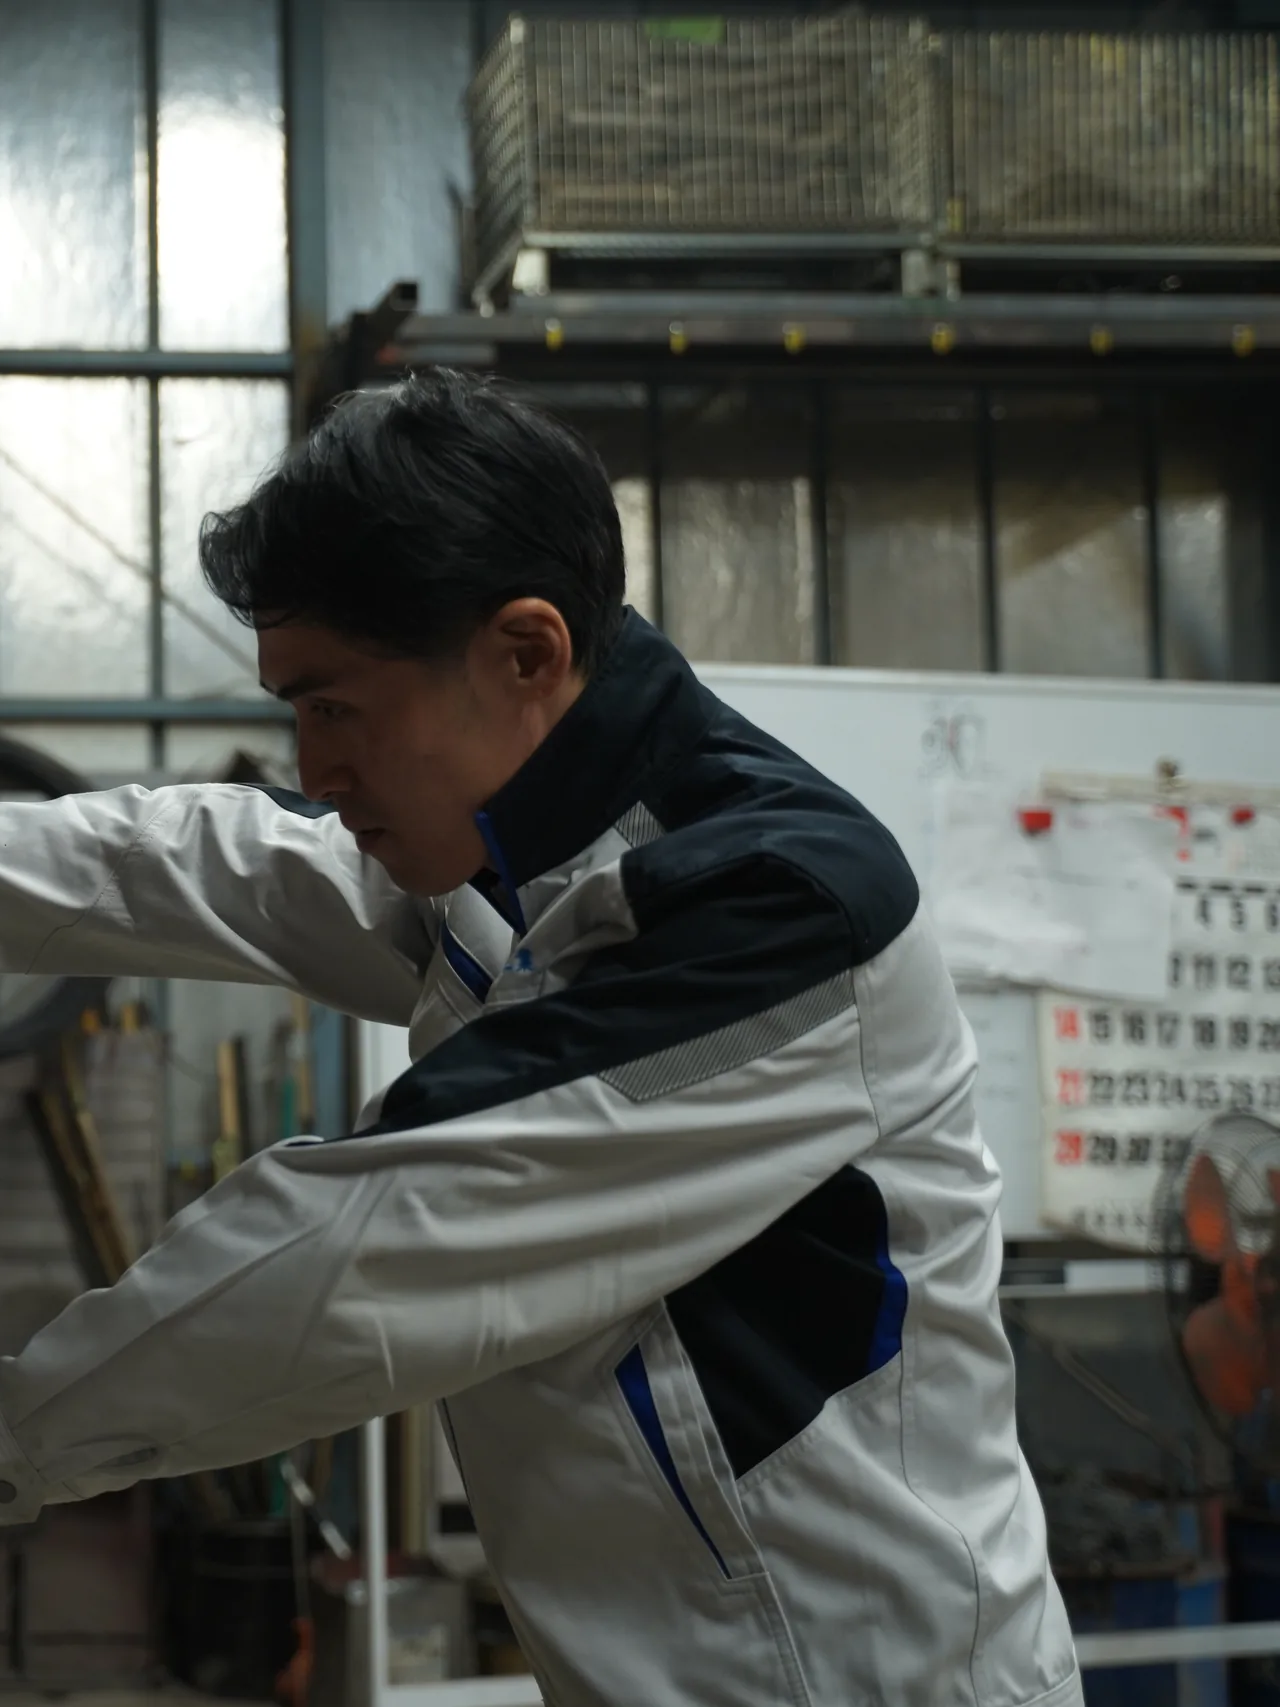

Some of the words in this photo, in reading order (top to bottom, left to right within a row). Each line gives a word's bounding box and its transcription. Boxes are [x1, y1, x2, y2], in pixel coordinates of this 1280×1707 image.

[1230, 899, 1245, 931] 5
[1192, 955, 1216, 990] 11
[1226, 957, 1251, 992] 12
[1056, 1007, 1080, 1041] 14
[1090, 1009, 1111, 1043] 15
[1124, 1010, 1147, 1045] 16
[1158, 1012, 1180, 1048] 17
[1193, 1013, 1216, 1048] 18
[1229, 1016, 1250, 1048] 19
[1058, 1070, 1084, 1106] 21
[1089, 1071, 1116, 1105] 22
[1123, 1072, 1149, 1107] 23
[1157, 1073, 1186, 1106] 24
[1192, 1075, 1221, 1108] 25
[1227, 1076, 1255, 1111] 26
[1056, 1131, 1083, 1165] 28
[1089, 1132, 1117, 1164] 29
